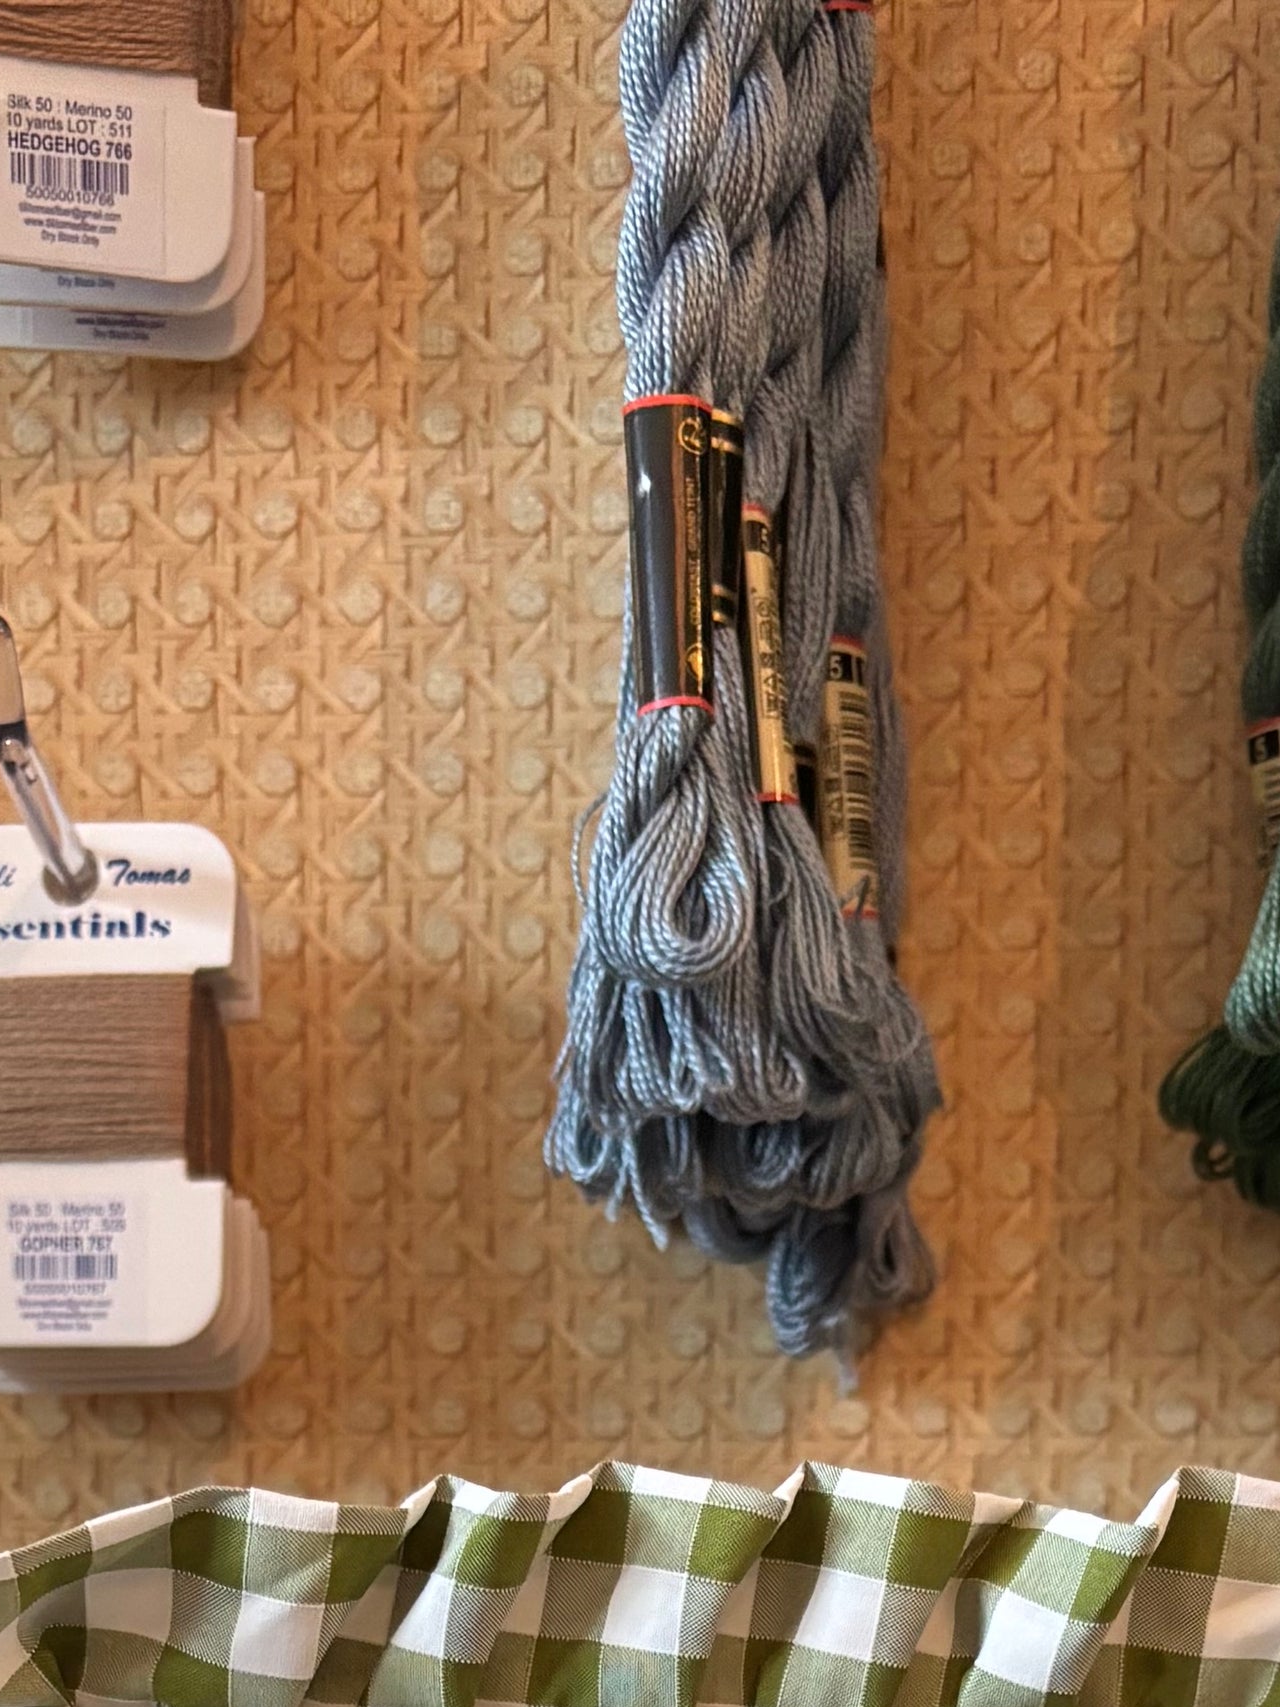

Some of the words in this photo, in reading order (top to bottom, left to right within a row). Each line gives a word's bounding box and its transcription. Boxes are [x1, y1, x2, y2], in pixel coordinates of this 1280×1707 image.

[7, 94, 31, 110] Silk
[35, 97, 52, 113] 50
[65, 100, 112, 119] Merino
[115, 106, 132, 121] 50
[7, 112, 21, 127] 10
[25, 117, 63, 132] yards
[68, 119, 97, 135] LOT
[108, 124, 132, 138] 511
[7, 130, 101, 156] HEDGEHOG
[105, 141, 132, 161] 766
[828, 655, 843, 680] 5
[107, 859, 191, 887] Tomas
[21, 1236, 83, 1252] GOPHER
